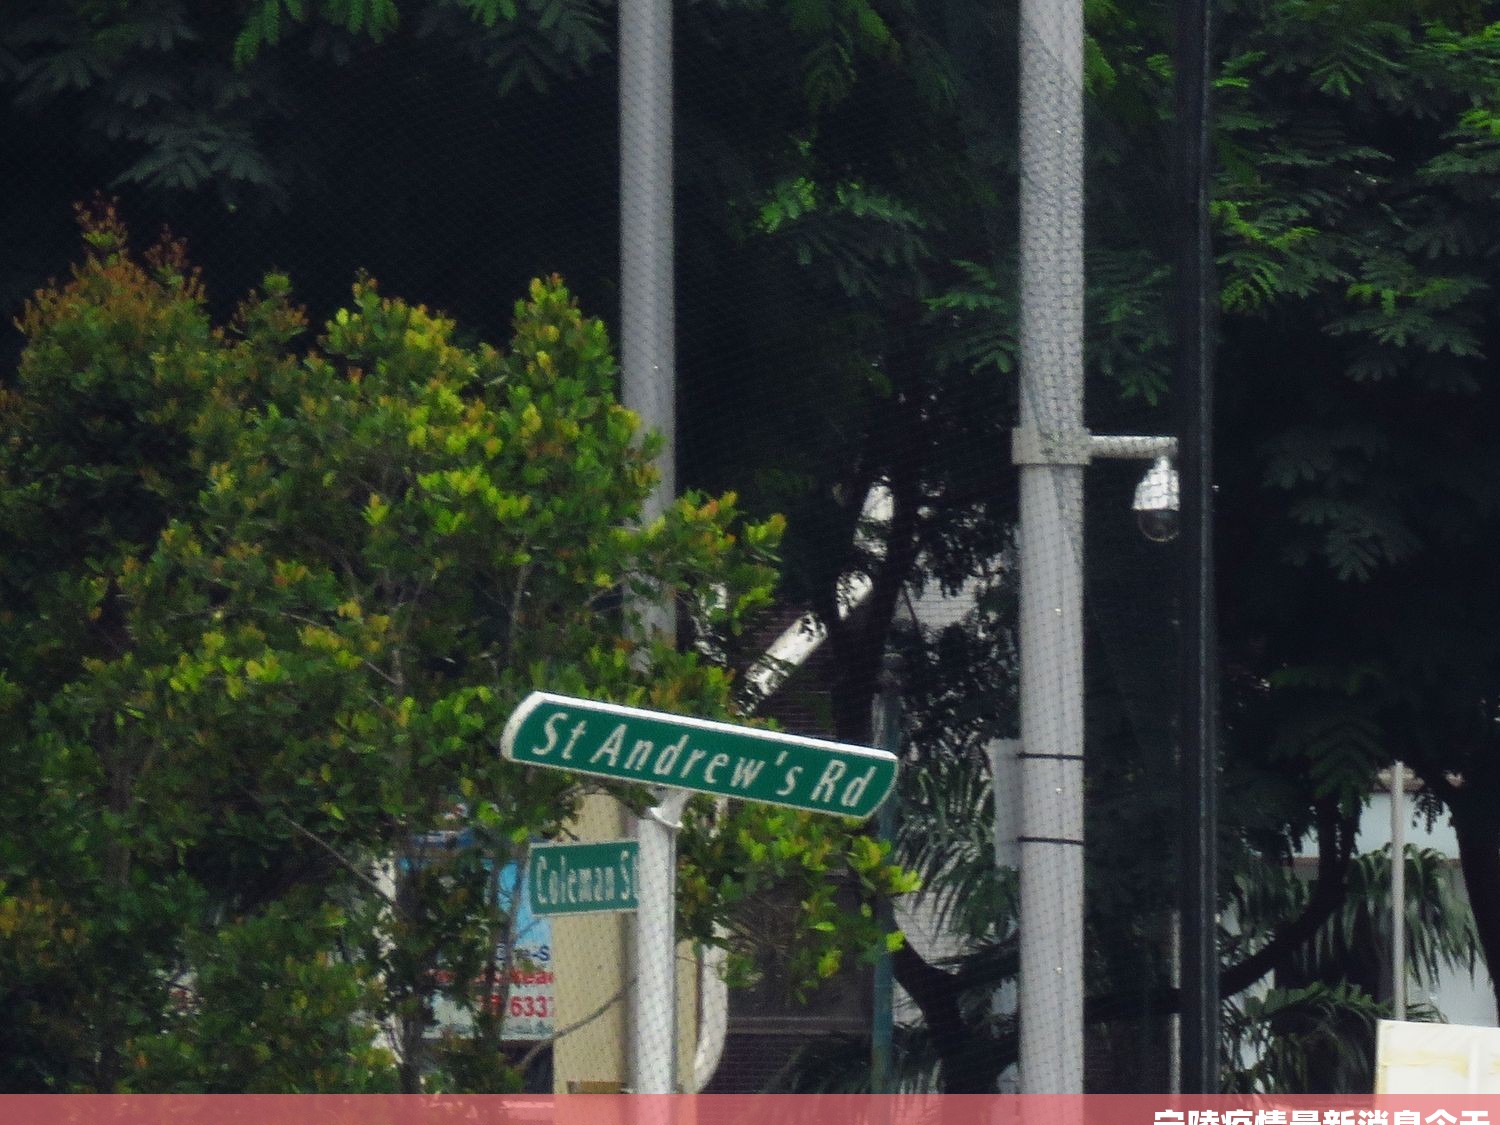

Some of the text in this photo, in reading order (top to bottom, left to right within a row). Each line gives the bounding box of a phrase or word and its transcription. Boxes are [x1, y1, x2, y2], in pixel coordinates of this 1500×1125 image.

[532, 713, 877, 808] St Andrew's Rd
[536, 855, 615, 905] Coleman
